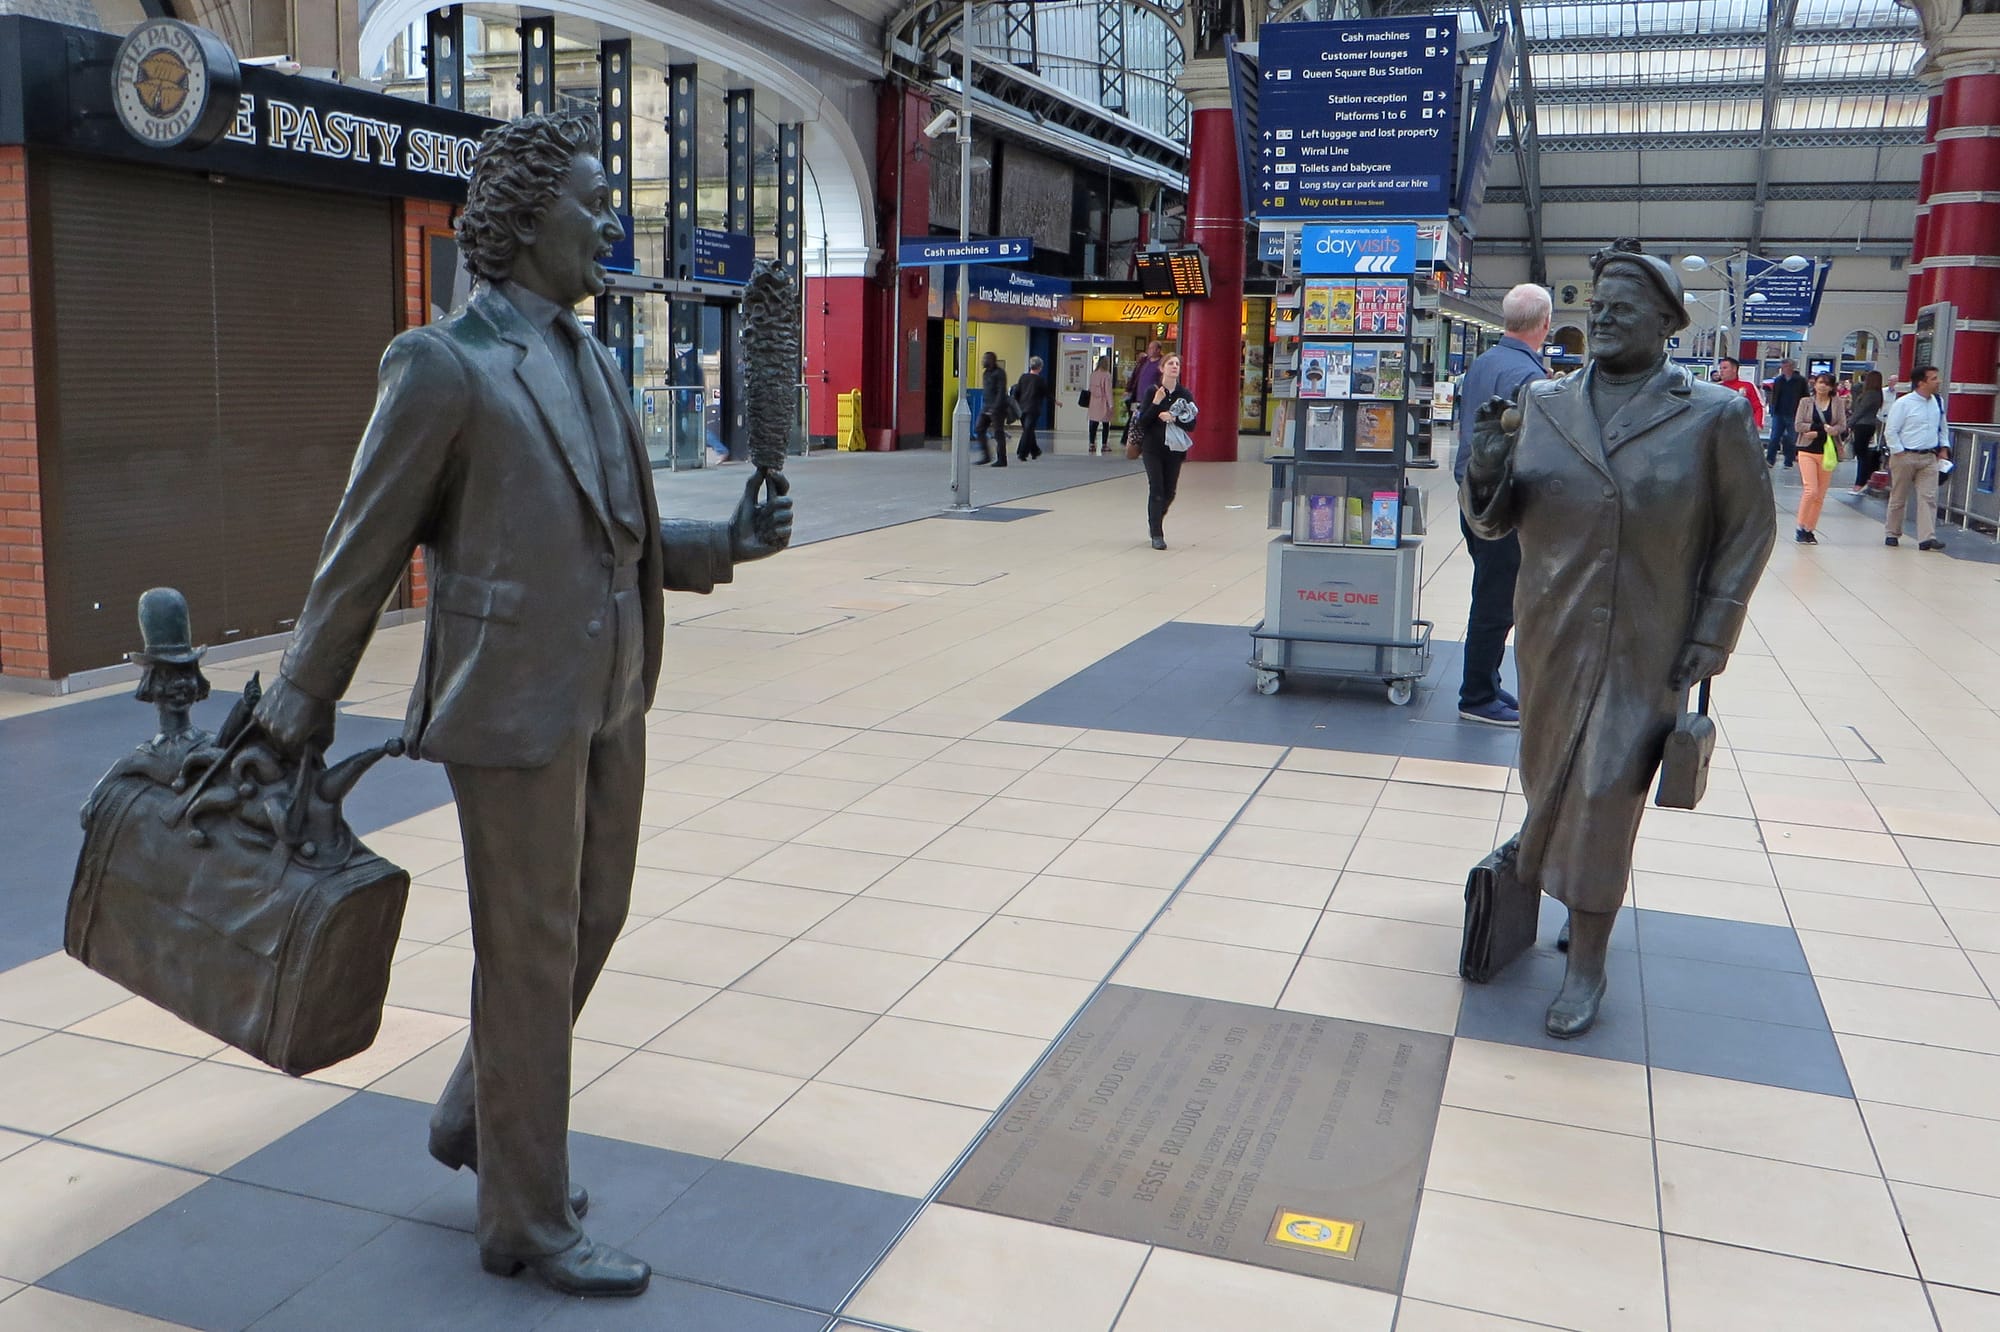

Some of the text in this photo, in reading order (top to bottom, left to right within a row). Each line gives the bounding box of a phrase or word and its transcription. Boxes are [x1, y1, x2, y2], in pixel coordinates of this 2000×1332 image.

[1341, 32, 1410, 42] Cash machines
[121, 27, 200, 88] THE PASTY
[1321, 50, 1407, 60] Customer lounges
[1303, 67, 1422, 79] Queen Square Bus Station
[1328, 94, 1407, 105] Station reception
[1336, 111, 1406, 121] Platforms 1 to 6
[143, 109, 190, 138] SHOP
[267, 99, 401, 166] PASTY
[406, 129, 480, 180] SHO
[1302, 128, 1438, 140] Left luggage and lost property
[1302, 147, 1349, 156] Wirral Line
[1301, 163, 1391, 173] Toilets and babycare
[1300, 181, 1320, 191] Long
[1323, 181, 1339, 190] stay
[1357, 179, 1375, 189] park
[1378, 179, 1393, 188] and
[1412, 179, 1428, 188] hire
[1300, 198, 1319, 207] Way
[924, 246, 989, 257] Cash machines
[980, 286, 1051, 309] Lime Street Low Level Station
[1122, 303, 1161, 320] Upper
[1981, 450, 1990, 481] 7
[1297, 590, 1379, 605] TAKE ONE
[1068, 1107, 1103, 1133] KEN
[1086, 1072, 1126, 1105] DODD
[1109, 1048, 1142, 1072] OBE
[1132, 1158, 1176, 1203] BESSIE
[1159, 1096, 1209, 1156] BRADDOCK
[1203, 1052, 1234, 1076] 1899
[1186, 1219, 1212, 1240] SHE
[1220, 1125, 1255, 1168] TIRELESSLY
